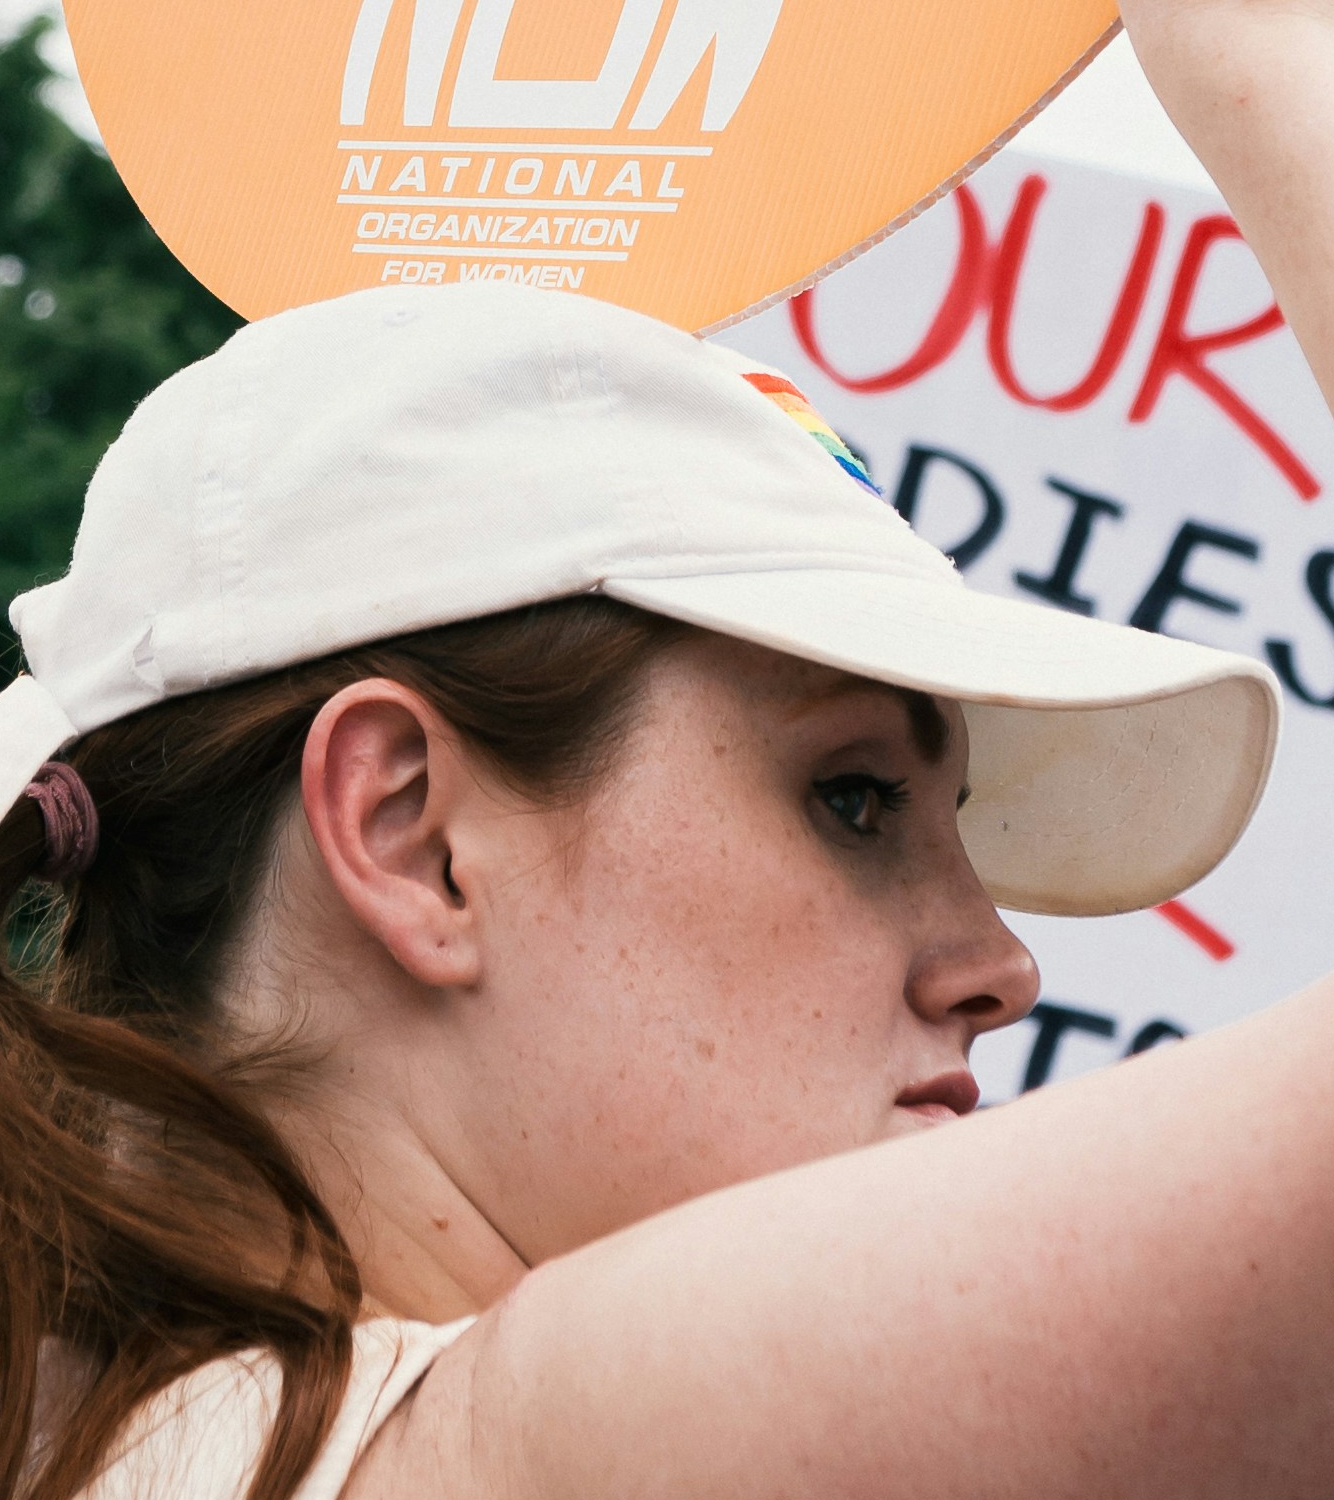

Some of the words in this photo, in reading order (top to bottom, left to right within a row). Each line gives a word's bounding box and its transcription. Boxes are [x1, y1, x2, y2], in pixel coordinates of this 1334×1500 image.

[340, 155, 686, 199] NATIONAL
[356, 211, 640, 247] ORGANIZATION
[380, 260, 446, 284] FOR
[458, 263, 585, 290] WOMEN
[787, 173, 1322, 502] OUR
